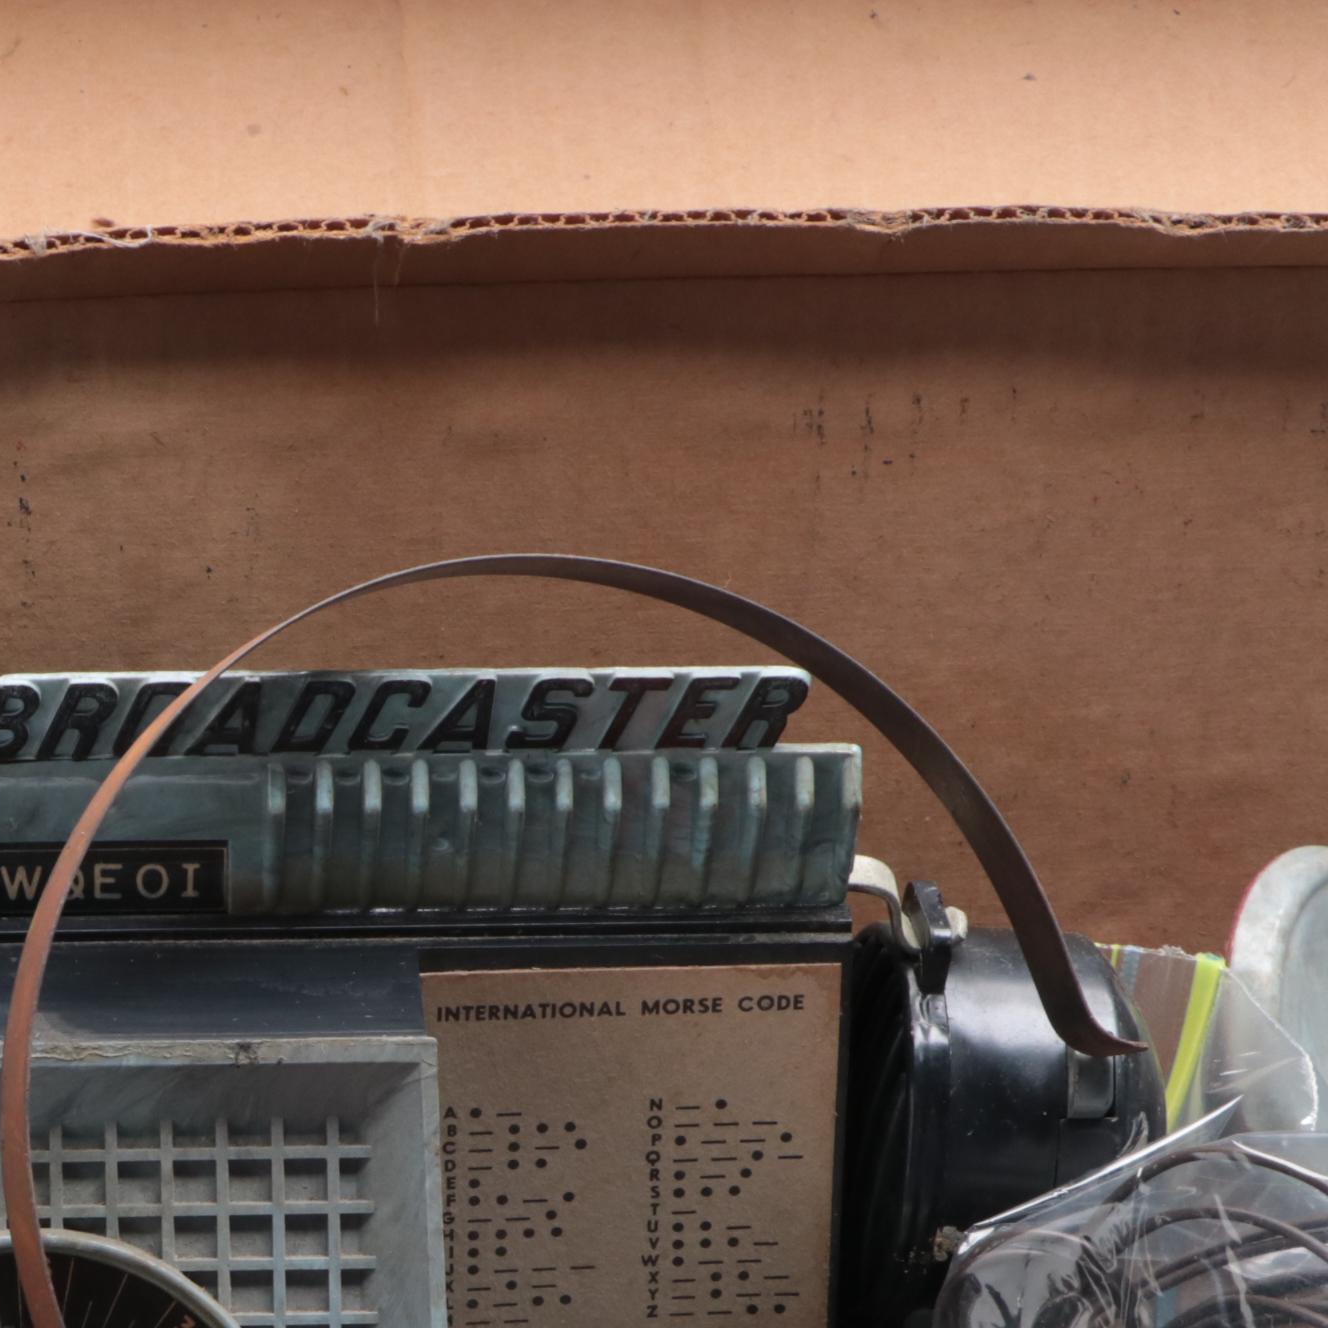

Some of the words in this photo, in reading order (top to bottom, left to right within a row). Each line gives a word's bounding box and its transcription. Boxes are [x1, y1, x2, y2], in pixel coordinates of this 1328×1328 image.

[437, 1002, 625, 1022] INTERNATIONAL
[642, 998, 722, 1015] MORSE
[738, 995, 804, 1012] CODE
[650, 1099, 662, 1111] N
[444, 1107, 457, 1118] A
[447, 1125, 456, 1137] B
[652, 1134, 661, 1146] P
[443, 1142, 456, 1154] C
[646, 1151, 661, 1166] Q
[445, 1160, 456, 1172] D
[650, 1168, 660, 1181] R
[447, 1177, 456, 1190] E
[651, 1186, 660, 1198] S
[447, 1194, 456, 1207] F
[651, 1203, 660, 1215] T
[443, 1212, 455, 1225] G
[647, 1220, 658, 1233] U
[649, 1238, 659, 1249] V
[642, 1255, 659, 1266] W
[446, 1264, 454, 1276] J
[649, 1271, 659, 1283] X
[648, 1288, 658, 1300] Y
[647, 1305, 657, 1318] Z
